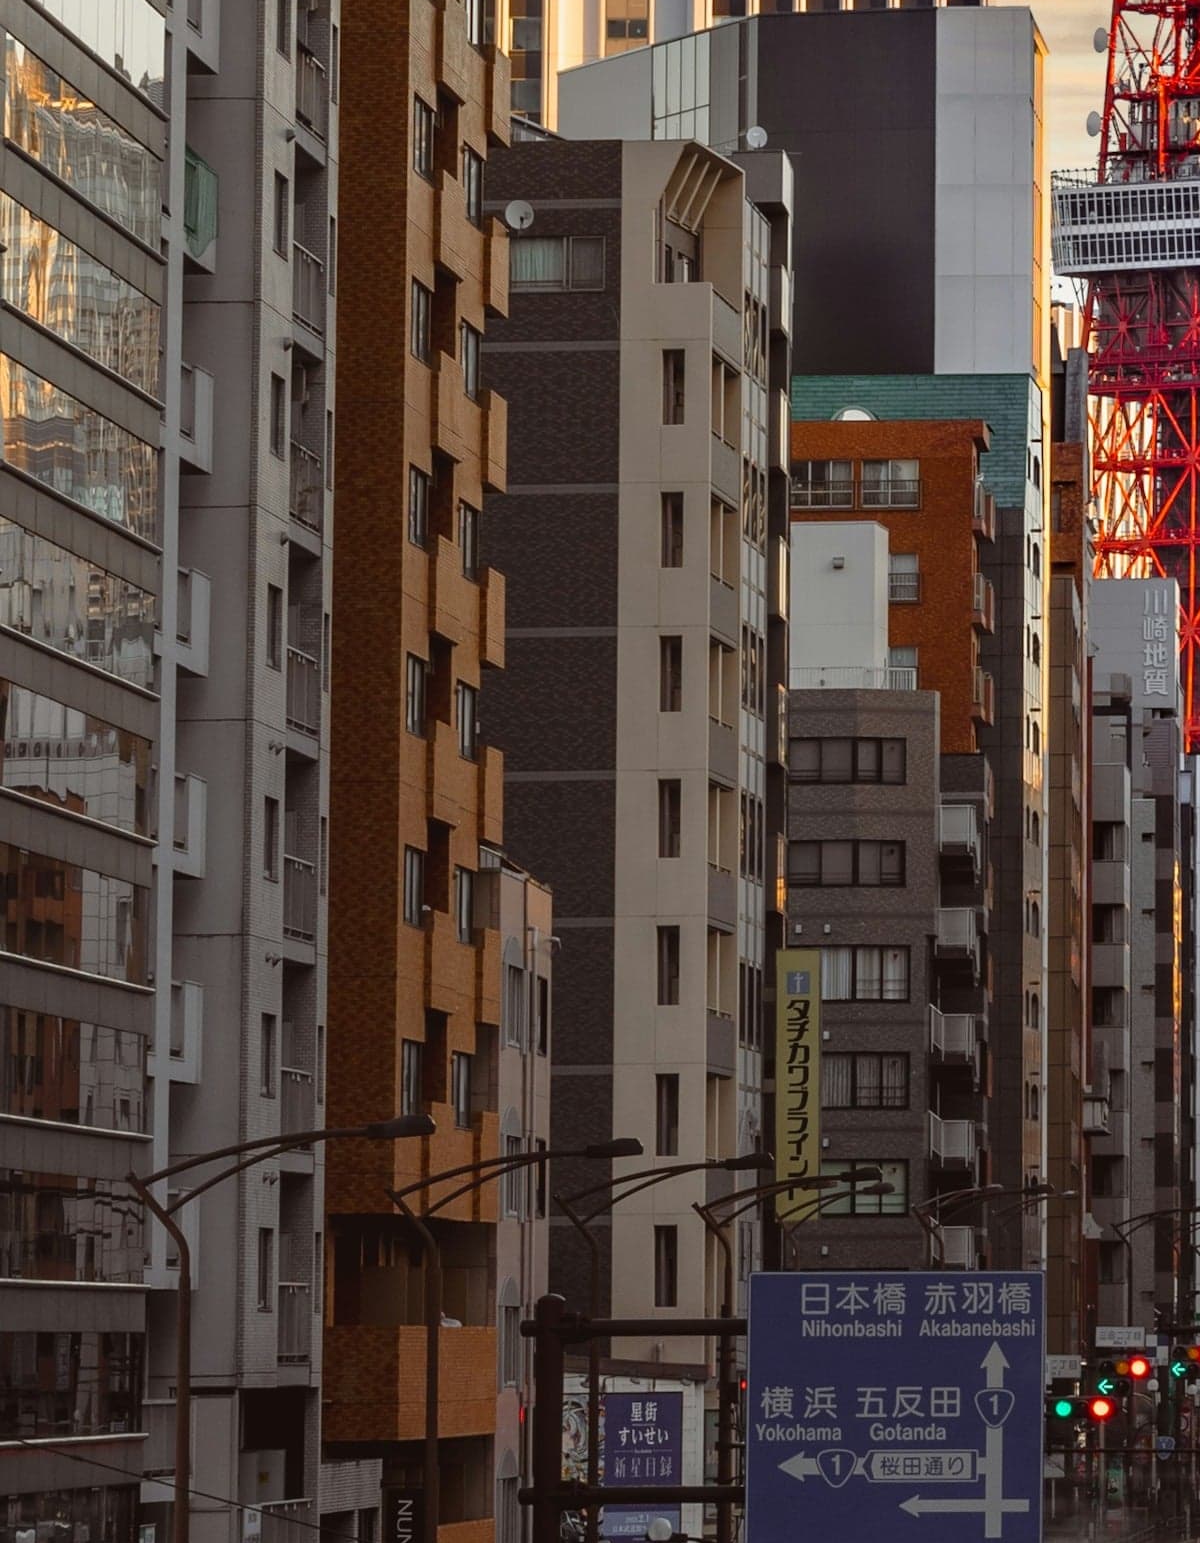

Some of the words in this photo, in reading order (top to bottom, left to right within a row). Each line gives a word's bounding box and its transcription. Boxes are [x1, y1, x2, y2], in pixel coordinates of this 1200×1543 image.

[801, 1282, 907, 1316] 日本橋
[924, 1282, 1032, 1316] 赤羽橋
[802, 1319, 902, 1337] Nihonbashi
[919, 1319, 1036, 1337] Akabanebashi
[630, 1401, 658, 1422] 星街
[760, 1386, 838, 1419] 横浜
[856, 1386, 961, 1419] 五反田
[989, 1395, 999, 1415] 1
[618, 1426, 669, 1447] すいせい
[756, 1424, 842, 1442] Yokohama
[870, 1423, 947, 1441] Gotanda
[832, 1455, 841, 1476] 1
[880, 1456, 966, 1476] 桜田通り
